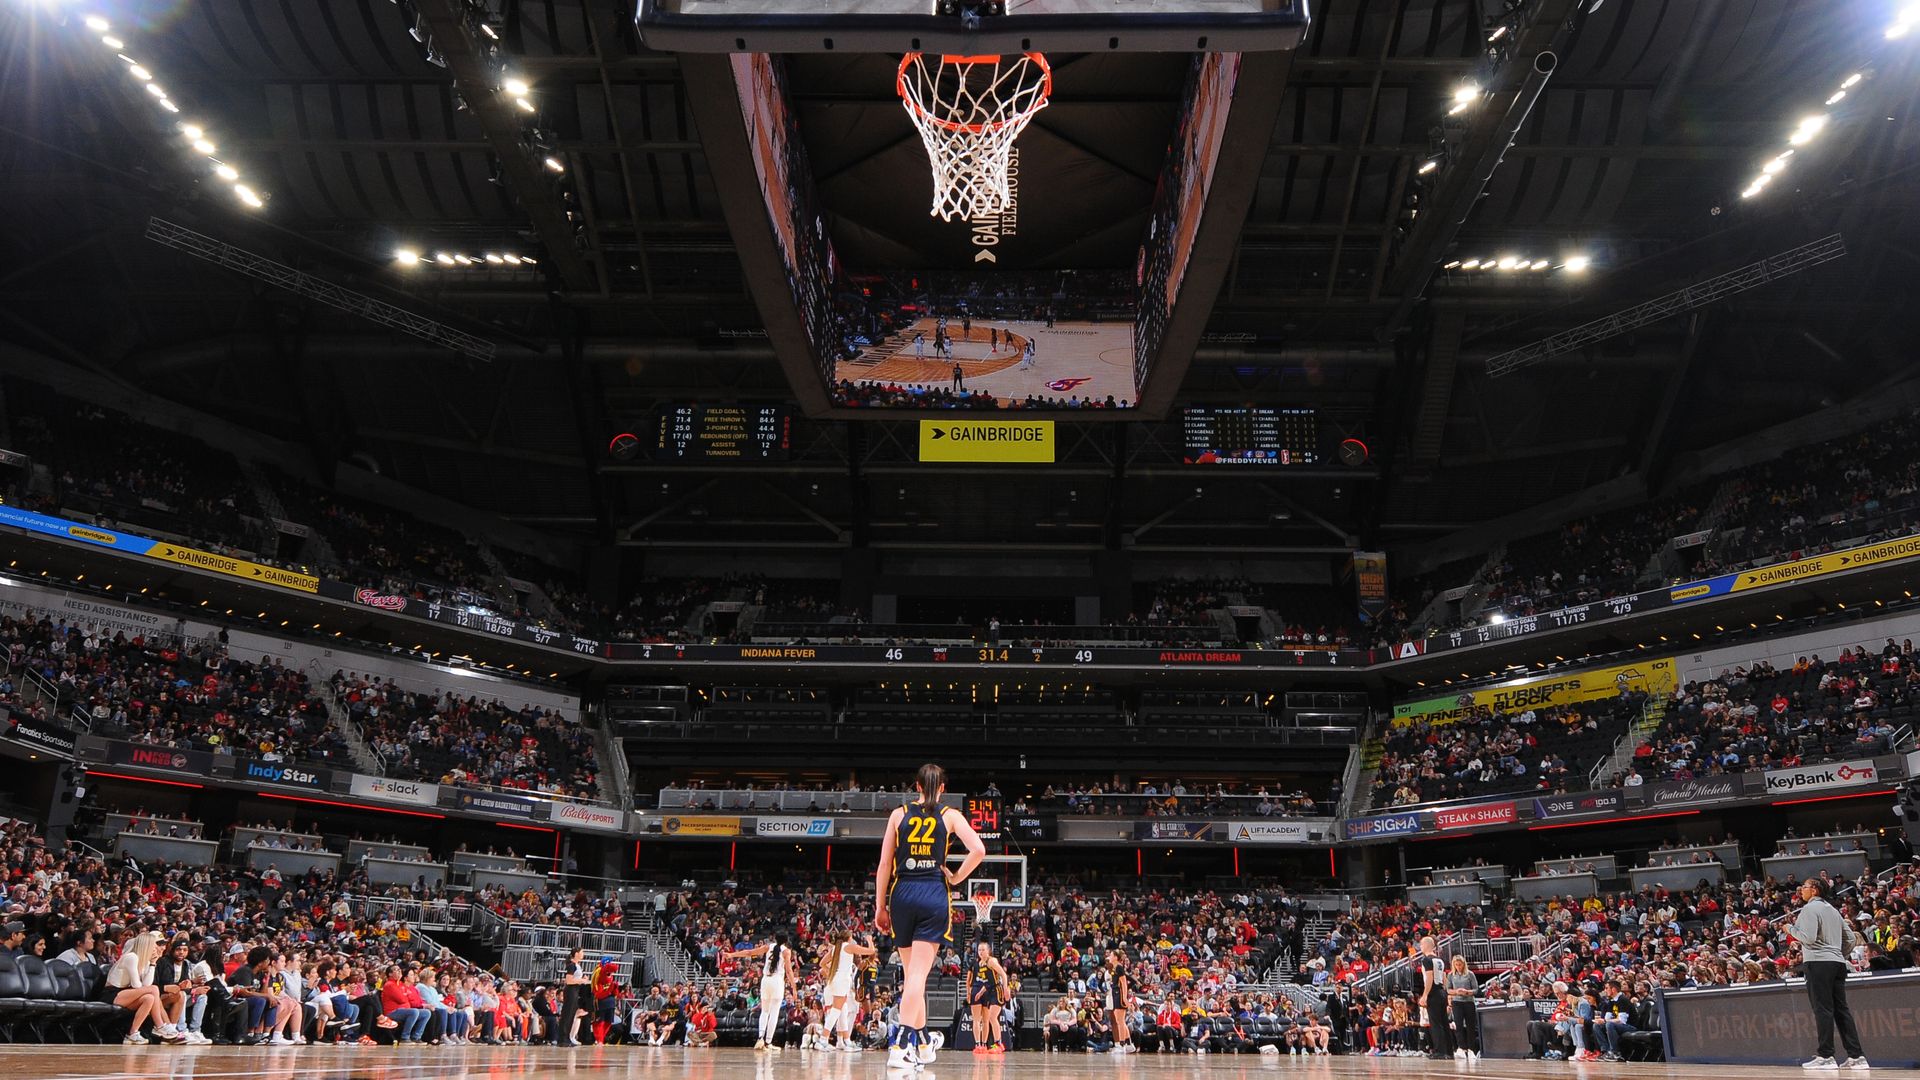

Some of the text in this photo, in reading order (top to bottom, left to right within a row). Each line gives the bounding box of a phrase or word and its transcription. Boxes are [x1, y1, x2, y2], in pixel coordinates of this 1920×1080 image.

[950, 427, 1043, 441] GAINBRIDGE
[24, 517, 45, 527] future
[45, 522, 58, 530] now
[71, 528, 113, 542] gainbridge.io
[1853, 541, 1920, 563] GAINBRIDGE
[177, 550, 237, 572] GAINBRIDGE
[1360, 573, 1383, 584] HIGH
[1760, 562, 1822, 582] GAINBRIDGE
[264, 570, 319, 589] GAINBRIDGE
[358, 588, 407, 610] Fever
[1671, 587, 1708, 599] gainbridge.io
[1604, 595, 1638, 608] 3-POINT FG
[64, 599, 159, 624] NEED ASSISTANCE?
[428, 610, 440, 619] 17
[1550, 605, 1590, 619] FREE THROWS
[1613, 601, 1632, 616] 4/9
[457, 616, 468, 626] 12
[498, 618, 515, 627] GOALS
[1518, 616, 1538, 625] GOALS
[1556, 611, 1586, 625] 11/13
[485, 623, 512, 636] 18/39
[1507, 623, 1537, 636] 17/38
[535, 634, 551, 645] 5/7
[572, 636, 591, 645] 3-POINT
[1451, 638, 1461, 648] 17
[1478, 632, 1489, 642] 12
[575, 643, 595, 654] 4/16
[644, 649, 650, 658] 4
[677, 651, 683, 659] 4
[741, 648, 815, 658] INDIANA FEVER
[885, 649, 902, 660] 46
[935, 653, 947, 661] 24
[978, 649, 1008, 662] 31.4
[1034, 654, 1040, 662] 2
[1075, 650, 1092, 662] 49
[1160, 652, 1241, 662] ATLANTA DREAM
[1297, 656, 1303, 664] 5
[1330, 656, 1336, 664] 4
[1651, 662, 1668, 670] 101
[1494, 680, 1580, 701] TURNER'S
[1493, 692, 1552, 712] BLOCK
[1398, 706, 1412, 714] 101
[16, 724, 74, 749] Fanatics Sportsbook
[133, 750, 153, 763] IN
[248, 763, 318, 784] IndyStar.
[1767, 771, 1835, 789] KeyBank
[387, 782, 419, 796] slack
[1688, 783, 1732, 800] Michelle
[481, 799, 494, 807] GROW
[494, 800, 520, 811] BASKETBALL
[520, 804, 532, 812] HERE
[560, 805, 614, 824] Bally SPORTS
[971, 810, 996, 830] 24
[1438, 813, 1469, 824] STEAK
[1477, 808, 1511, 821] SHAKE
[759, 823, 826, 832] SECTION 127
[907, 816, 937, 843] 22
[1348, 816, 1417, 835] SHIPSIGMA
[1031, 828, 1042, 837] 49
[910, 844, 932, 855] CLARK
[916, 860, 936, 868] AT&T
[1706, 1015, 1760, 1040] DARK
